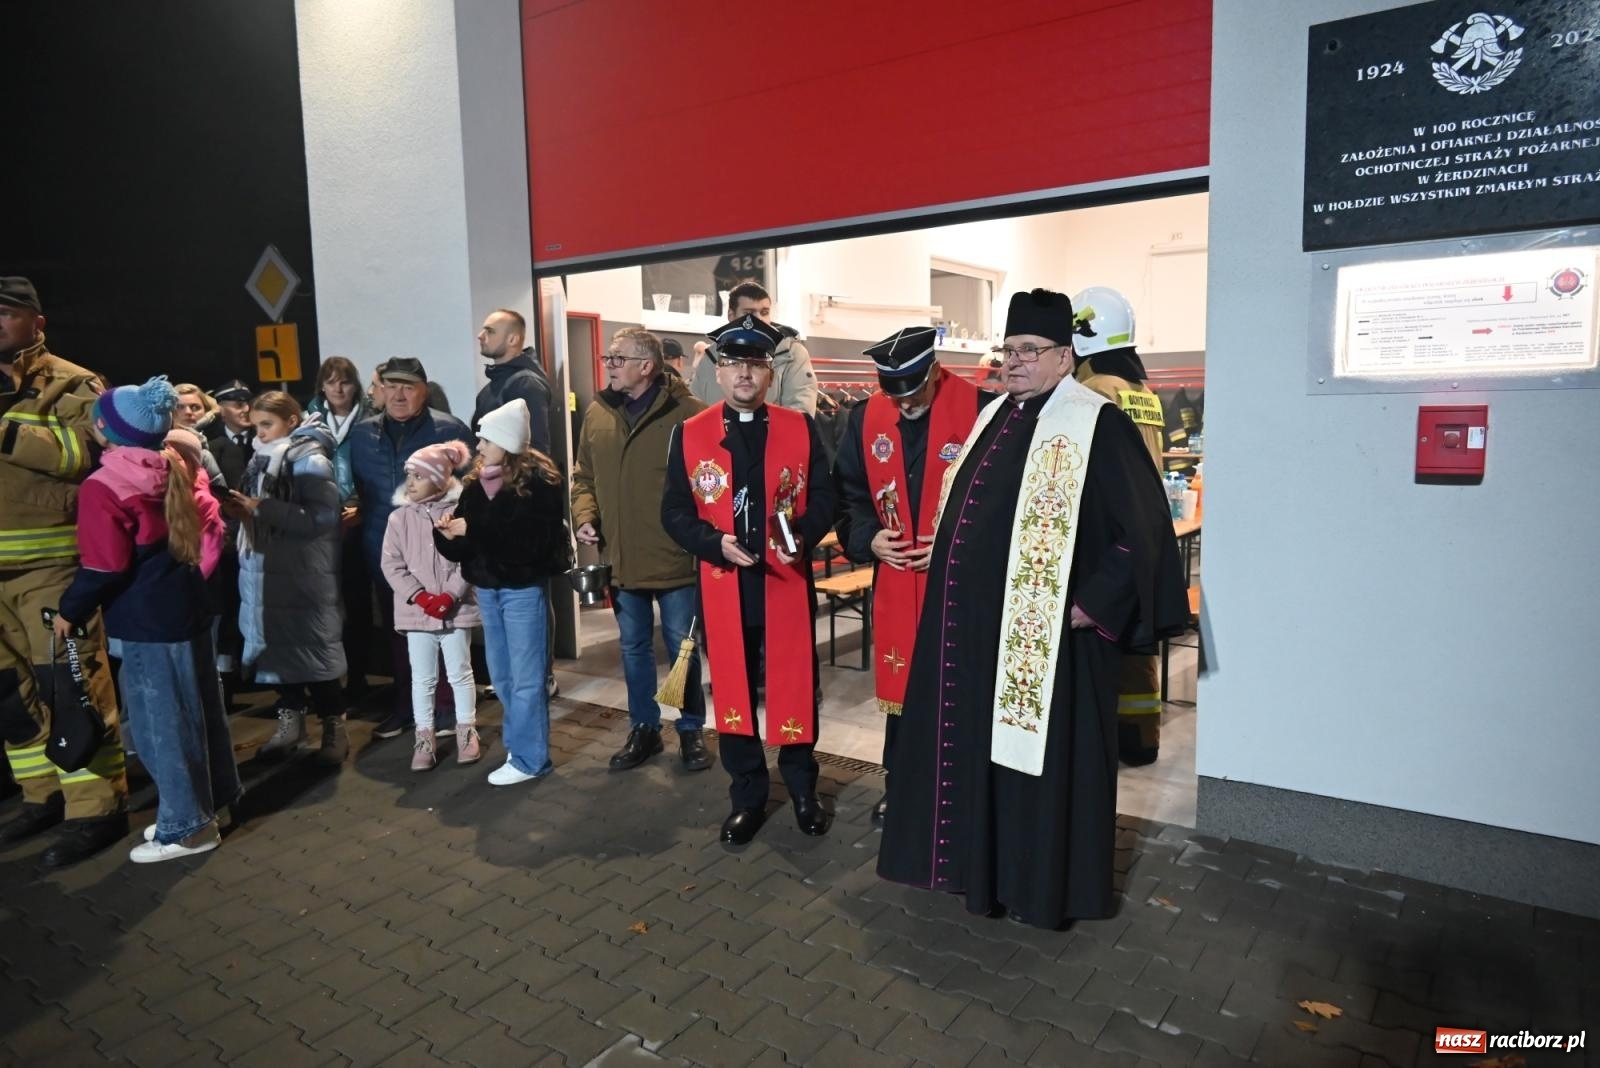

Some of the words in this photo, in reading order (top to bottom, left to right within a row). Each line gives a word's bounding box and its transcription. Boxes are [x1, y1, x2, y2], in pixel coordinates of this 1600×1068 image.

[1551, 29, 1600, 48] 202
[1356, 61, 1405, 81] 1924
[1413, 127, 1426, 137] W
[1432, 122, 1456, 134] 100
[1462, 111, 1536, 130] ROCZNICĘ
[1341, 143, 1416, 164] ZAŁOŻENIA
[1421, 142, 1426, 152] I
[1431, 132, 1501, 151] OFIARNEJ
[1355, 156, 1450, 177] OCHOTNICZEJ
[1455, 145, 1512, 165] STRAŻY
[1518, 136, 1600, 156] POŻARNEJ
[1418, 174, 1429, 185] W
[1435, 163, 1528, 183] ŻERDZINACH
[1313, 203, 1324, 213] W
[1329, 195, 1384, 211] HOŁDZIE
[1390, 186, 1470, 204] WSZYSTKIM
[1476, 177, 1547, 195] ZMARŁYM
